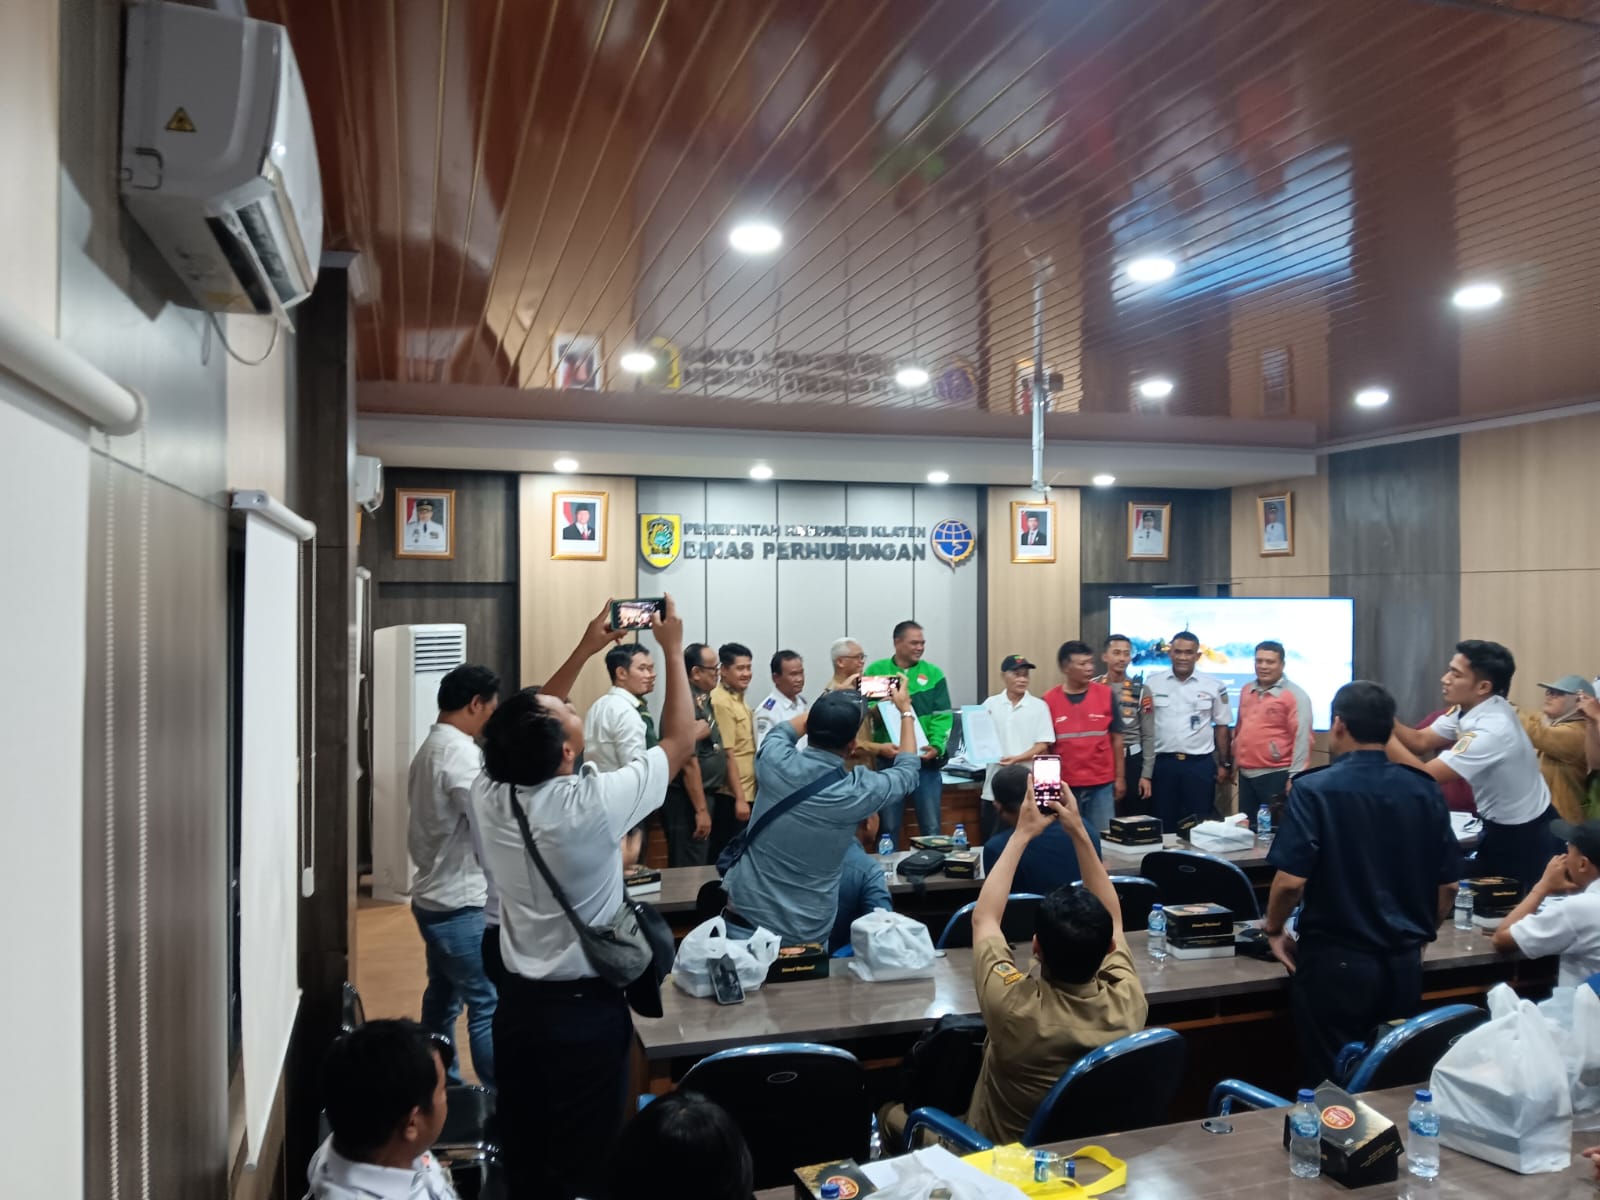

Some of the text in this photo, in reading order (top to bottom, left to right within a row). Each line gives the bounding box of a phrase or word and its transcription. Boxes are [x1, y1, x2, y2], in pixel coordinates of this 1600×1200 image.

[872, 526, 926, 538] KLATEN
[683, 542, 926, 560] DINAS PERHUBUNGAN
